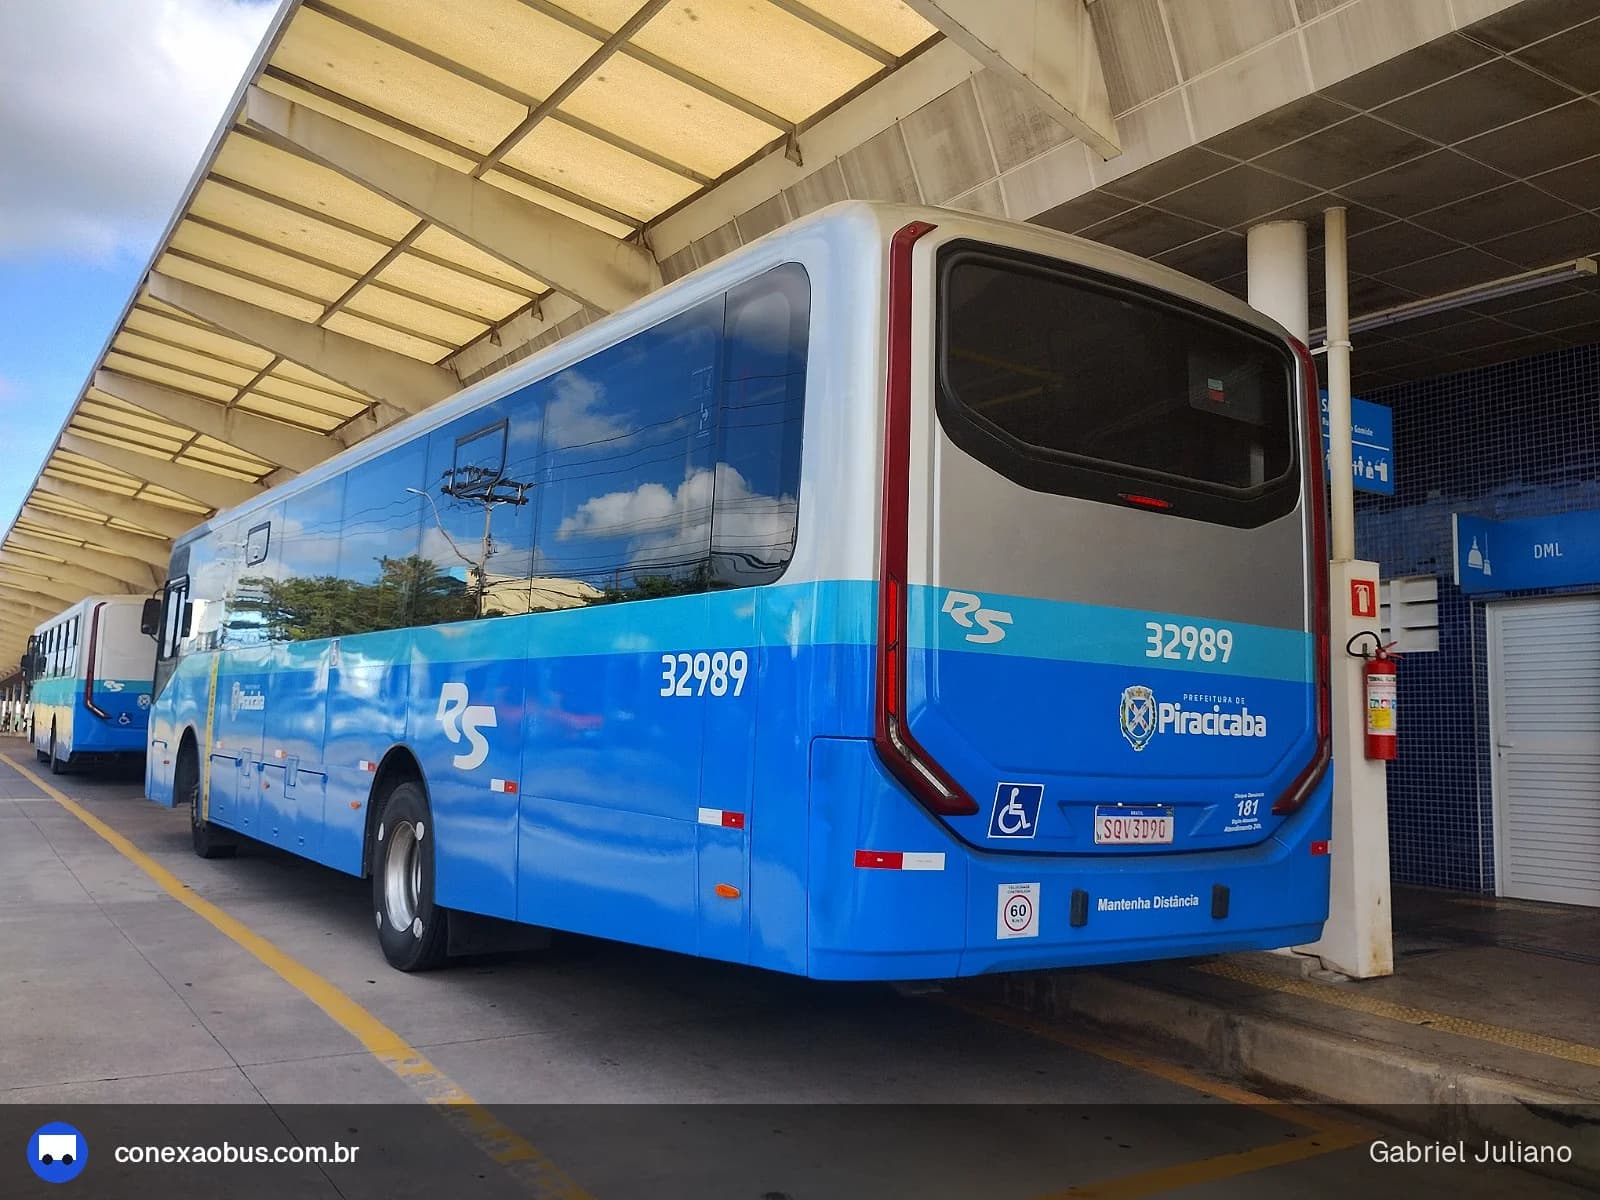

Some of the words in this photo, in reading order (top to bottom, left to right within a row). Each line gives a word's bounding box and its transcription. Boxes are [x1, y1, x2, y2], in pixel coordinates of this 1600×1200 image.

[1534, 542, 1563, 560] DML
[941, 591, 1013, 644] RS
[1145, 622, 1233, 663] 32989
[660, 650, 748, 697] 32989
[1183, 693, 1232, 704] PREFEITURA
[436, 682, 498, 771] RS
[1158, 702, 1267, 737] Piracicaba
[1237, 799, 1259, 816] 181
[1010, 904, 1027, 917] 60
[1098, 897, 1151, 911] Mantenha
[1153, 894, 1199, 909] Distância
